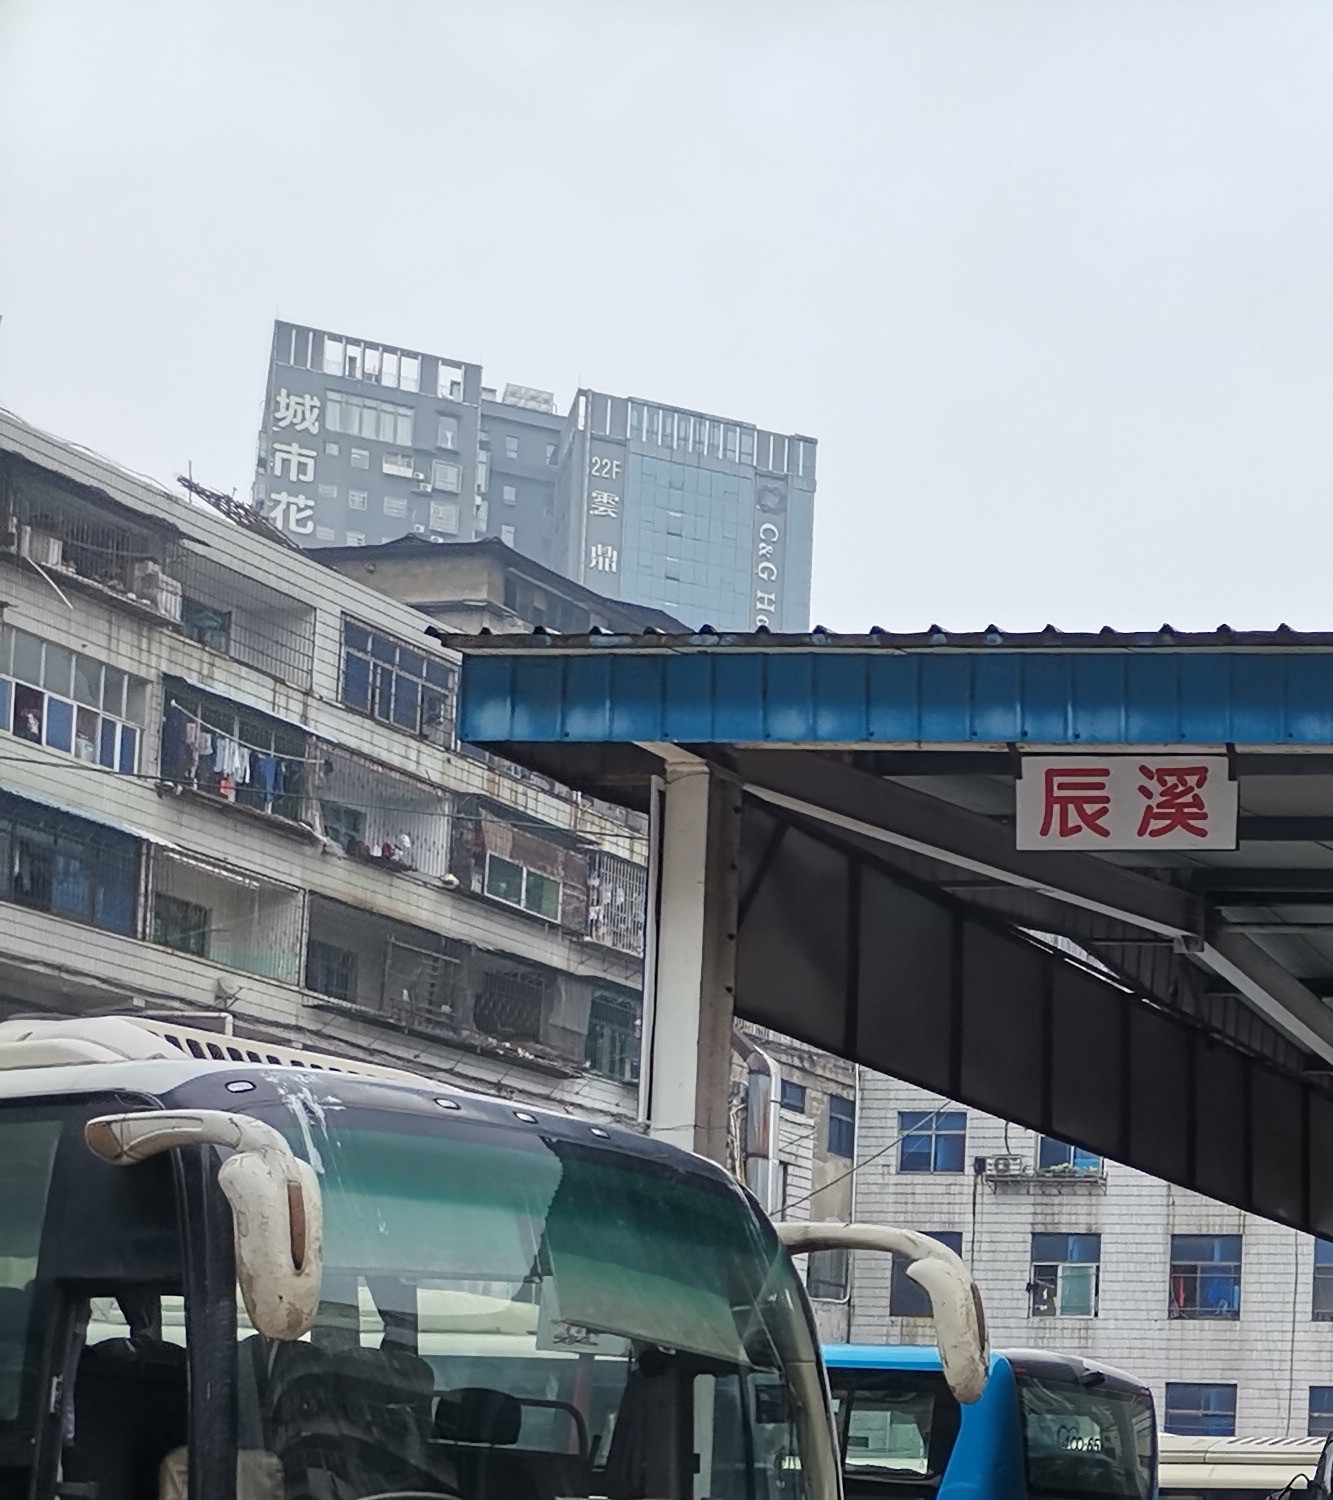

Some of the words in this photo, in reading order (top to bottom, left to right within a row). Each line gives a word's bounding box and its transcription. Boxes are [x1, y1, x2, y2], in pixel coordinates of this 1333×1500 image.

[269, 387, 322, 535] 城市花
[590, 455, 622, 480] 22F
[757, 522, 780, 582] C&G
[1039, 764, 1209, 838] 辰溪
